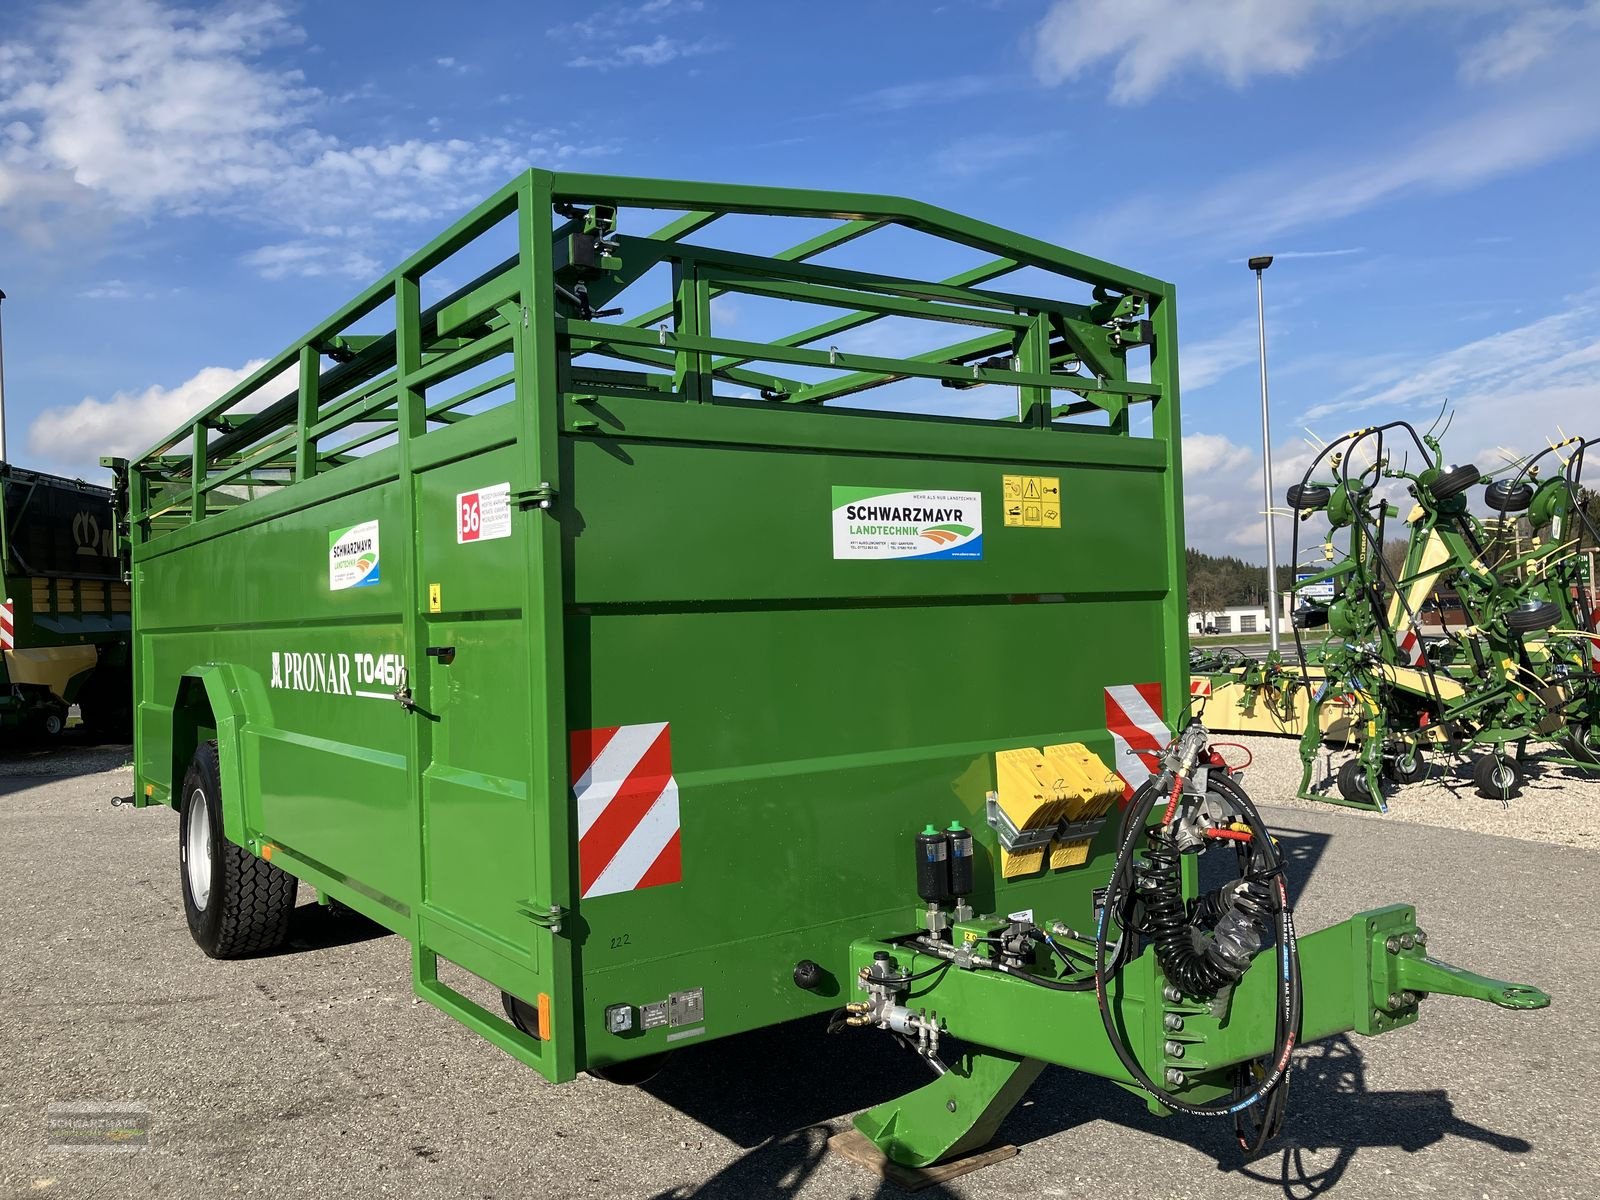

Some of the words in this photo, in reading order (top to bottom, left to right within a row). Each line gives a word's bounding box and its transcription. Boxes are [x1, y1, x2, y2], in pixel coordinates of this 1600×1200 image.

[462, 502, 480, 533] 36
[846, 505, 963, 522] SCHWARZMAYR
[850, 525, 919, 536] LANDTECHNIK
[334, 538, 372, 558] SCHWARZMAYR
[284, 652, 352, 696] PRONAR
[610, 934, 631, 949] 222
